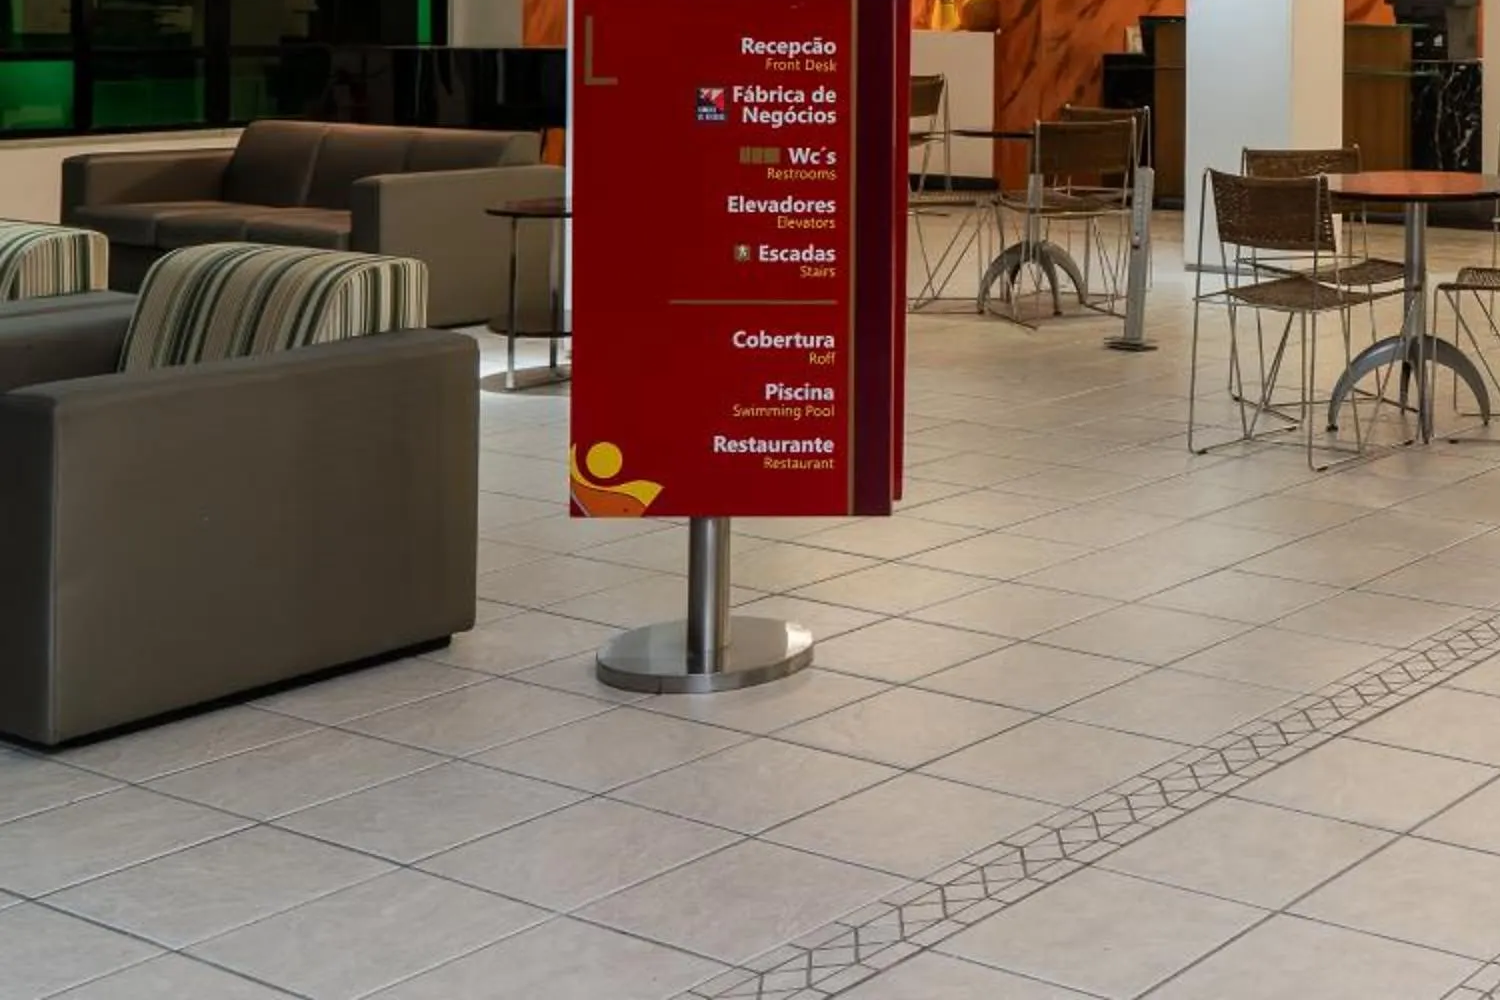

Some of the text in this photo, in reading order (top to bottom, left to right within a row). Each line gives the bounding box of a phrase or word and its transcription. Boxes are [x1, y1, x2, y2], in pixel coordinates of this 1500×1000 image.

[765, 58, 837, 73] Front Desk
[732, 85, 837, 103] Fábrica de
[742, 105, 837, 128] Negócios
[767, 167, 837, 181] Restrooms
[727, 196, 836, 213] Elevadores
[777, 216, 836, 229] Elevators
[759, 244, 836, 262] Escadas
[799, 265, 836, 278] Stairs
[732, 330, 836, 349] Cobertura
[809, 351, 836, 365] Roff
[765, 383, 835, 401] Piscina
[732, 404, 835, 420] Swimming Pool
[713, 435, 835, 454] Restaurante
[763, 457, 835, 470] Restaurant
